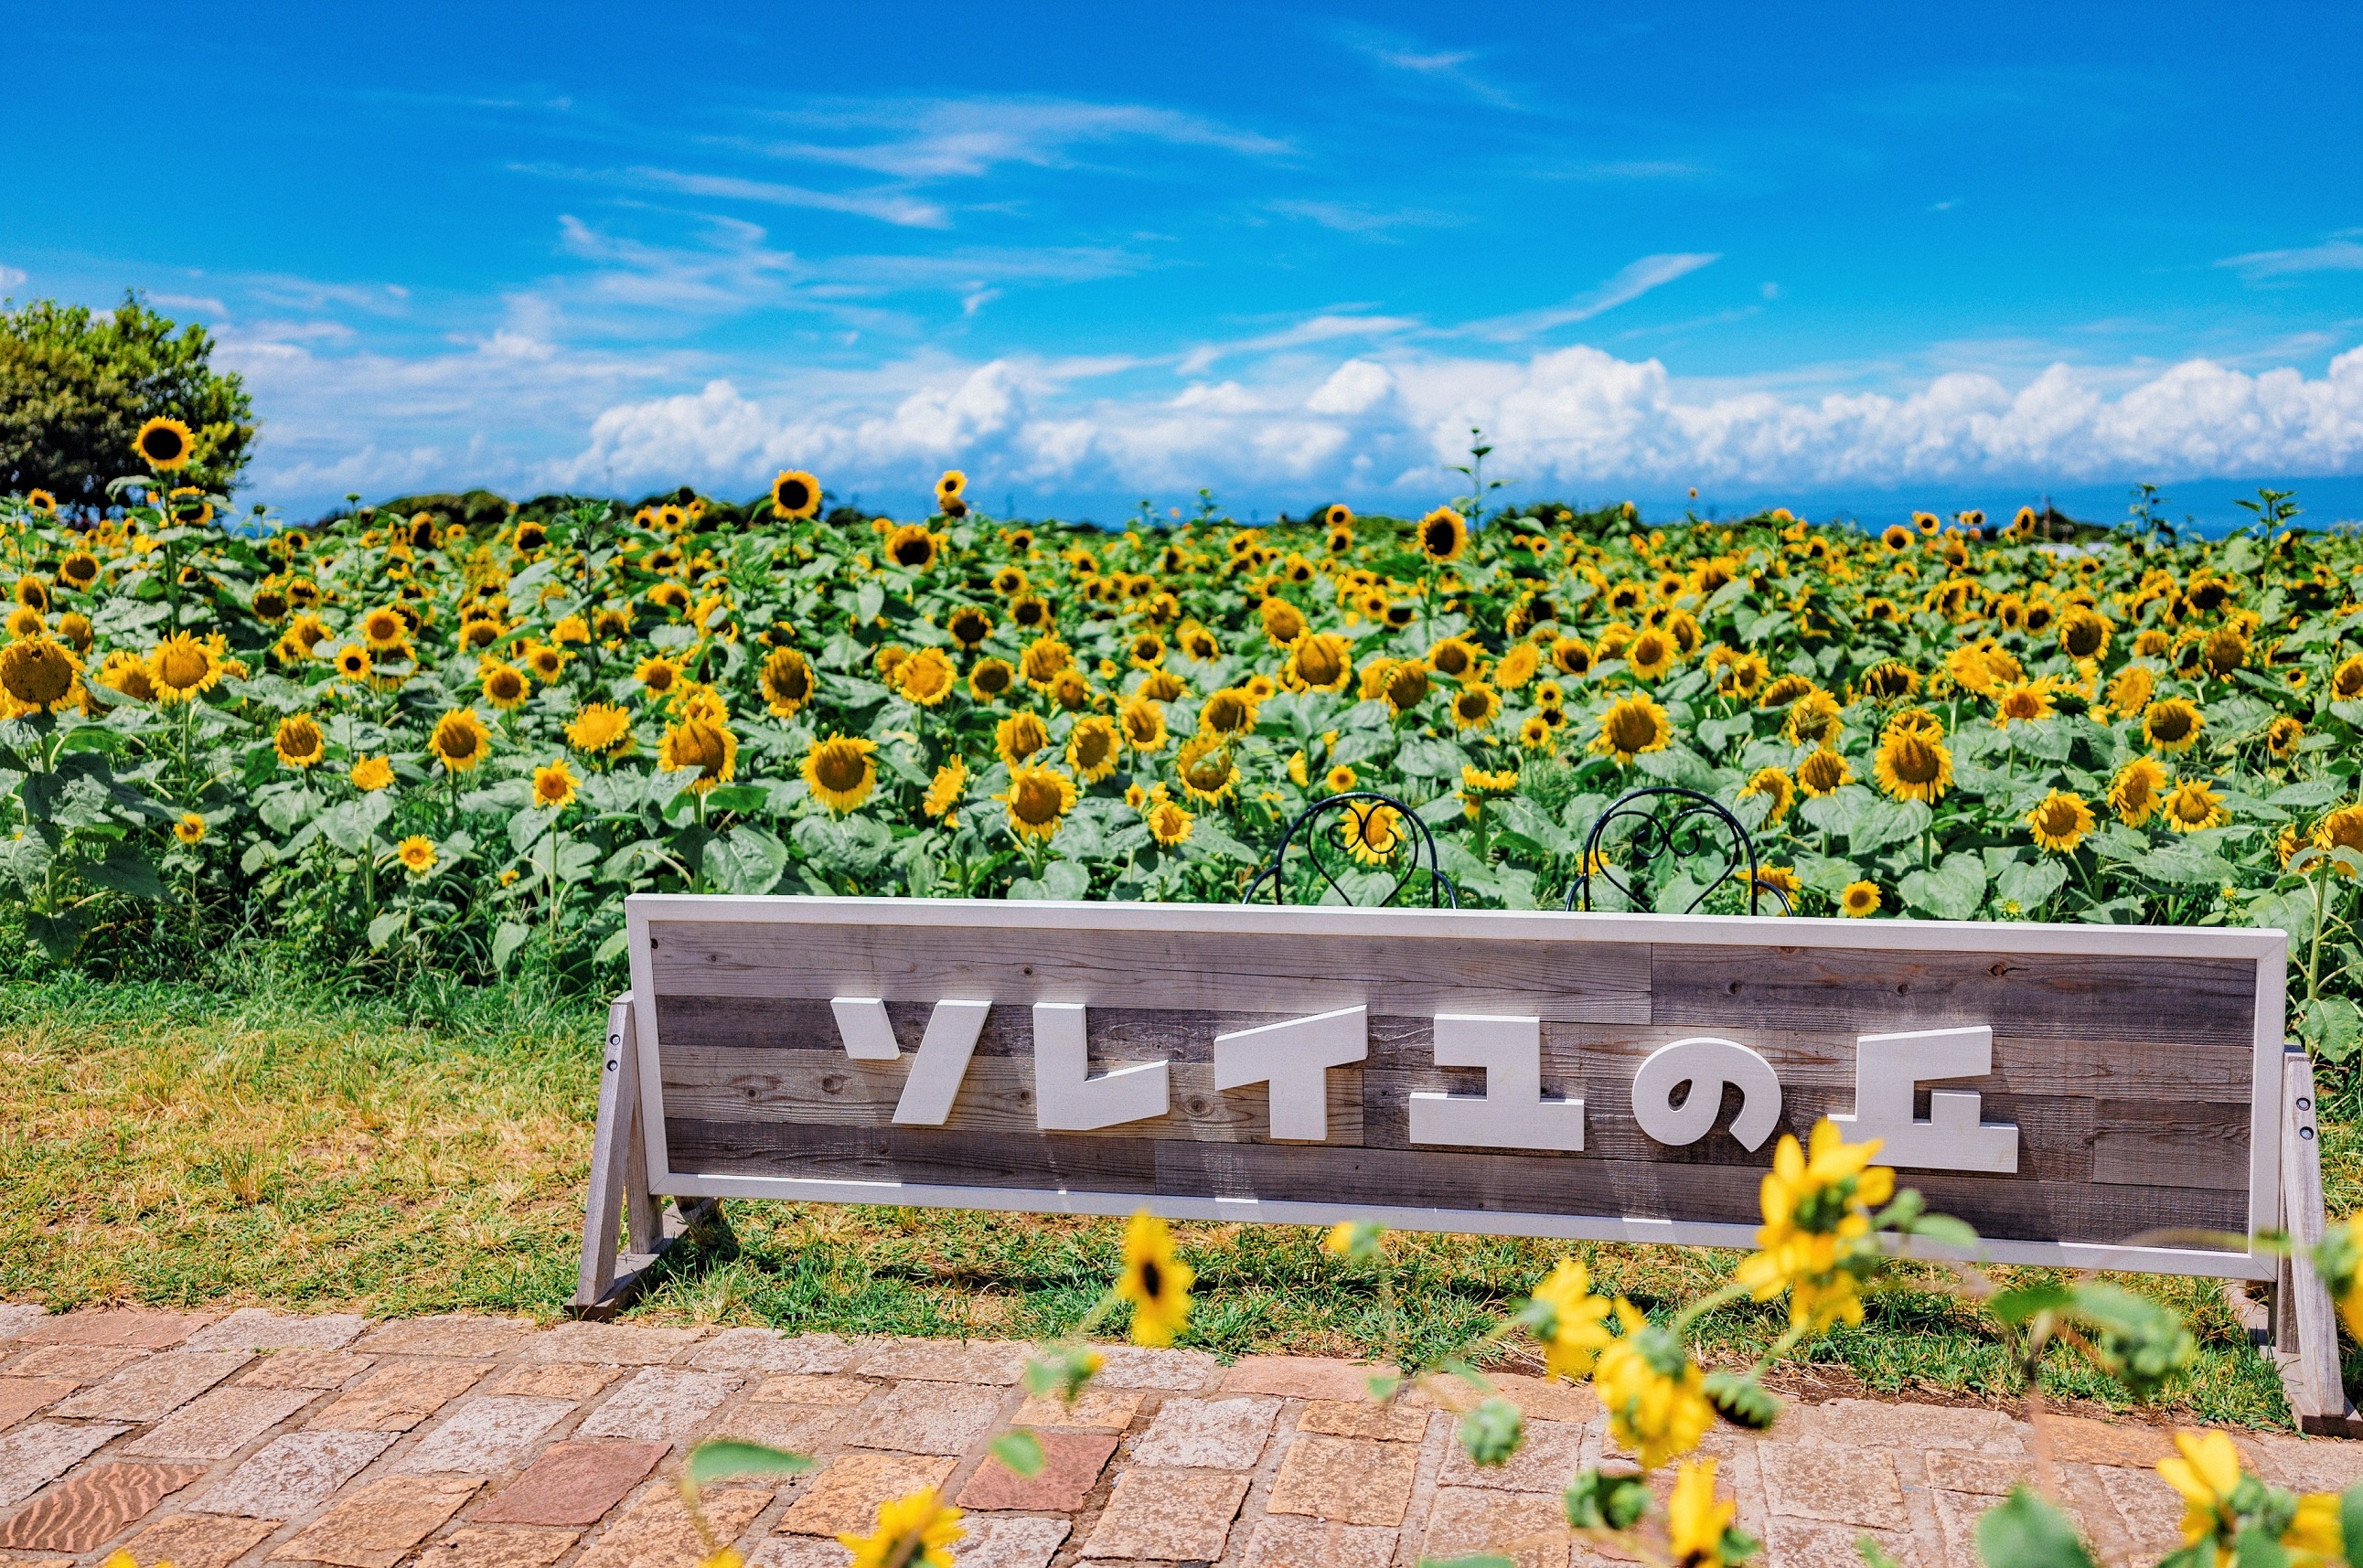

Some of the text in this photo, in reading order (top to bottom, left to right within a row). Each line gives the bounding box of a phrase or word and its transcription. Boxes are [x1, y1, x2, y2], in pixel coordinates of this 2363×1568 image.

[830, 997, 2018, 1172] ソレイユの丘
